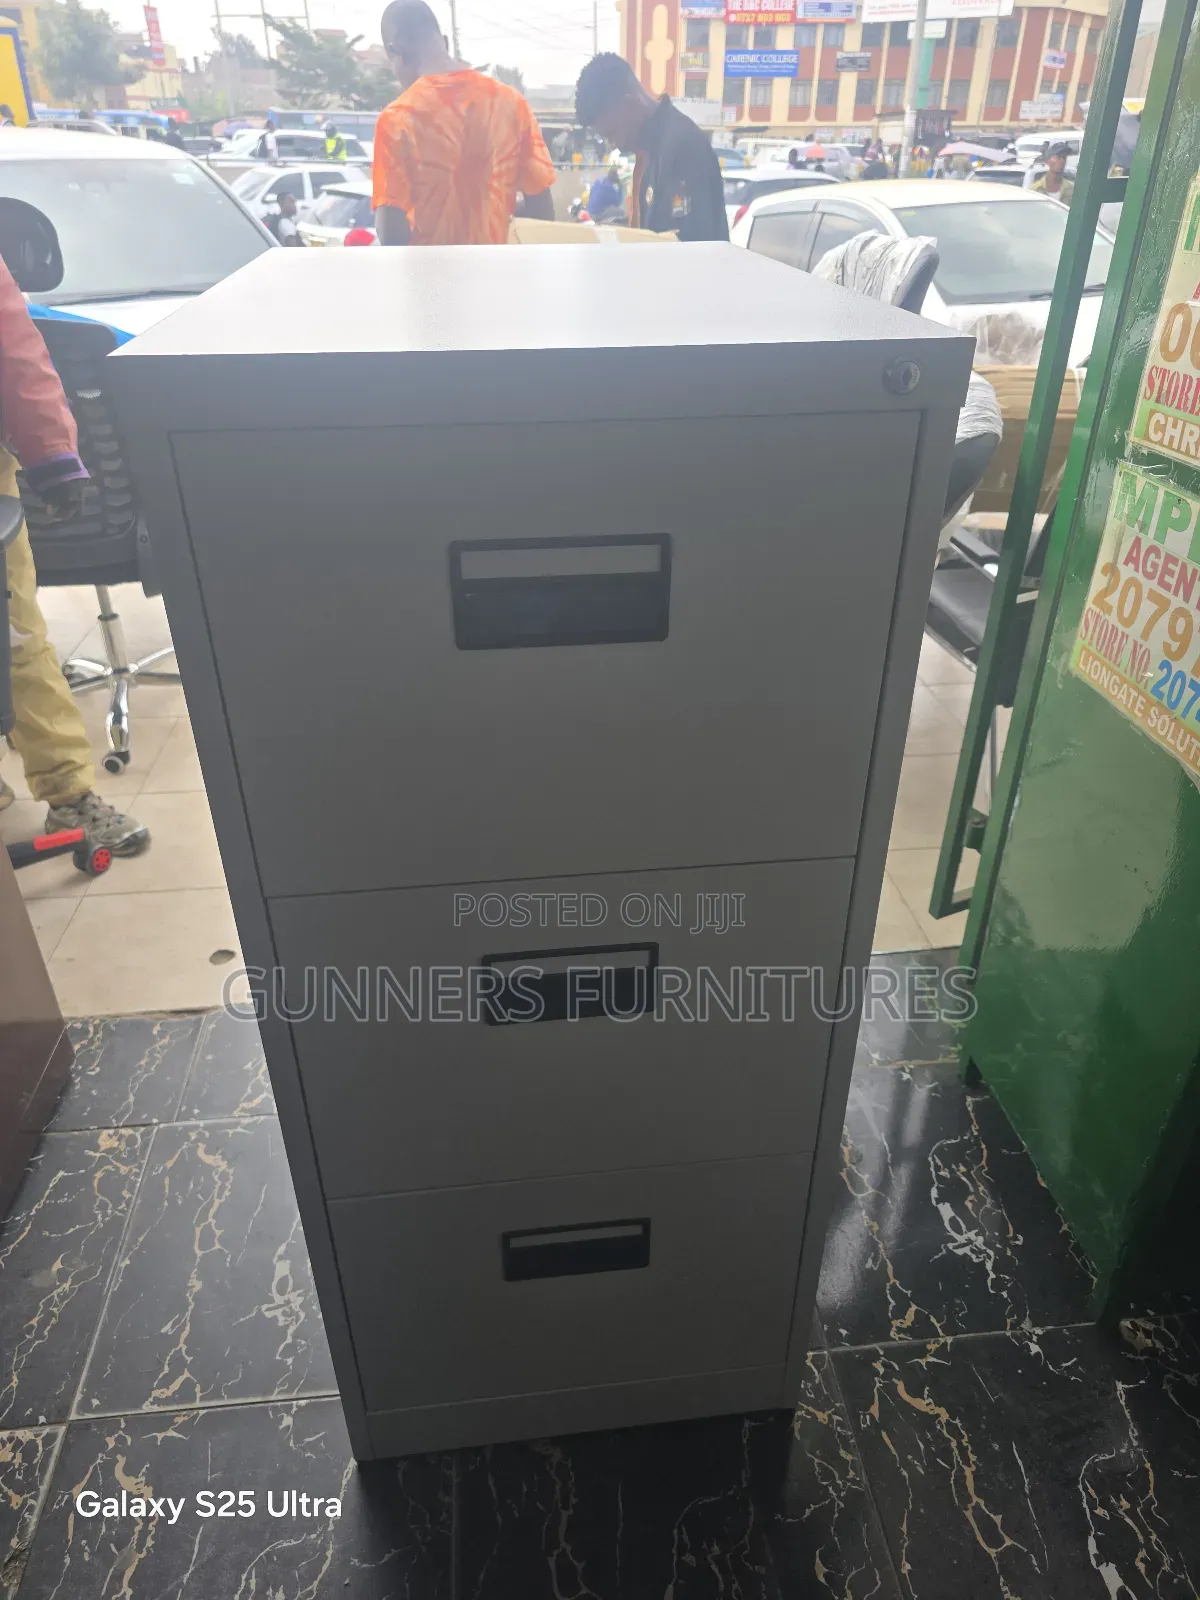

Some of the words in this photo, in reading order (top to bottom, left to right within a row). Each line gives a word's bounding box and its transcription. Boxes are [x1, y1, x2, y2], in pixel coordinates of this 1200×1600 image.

[762, 54, 798, 64] COLLEGE
[1123, 535, 1200, 610] AGEN
[1080, 607, 1129, 668] STORE
[1078, 650, 1147, 717] LIONGATE
